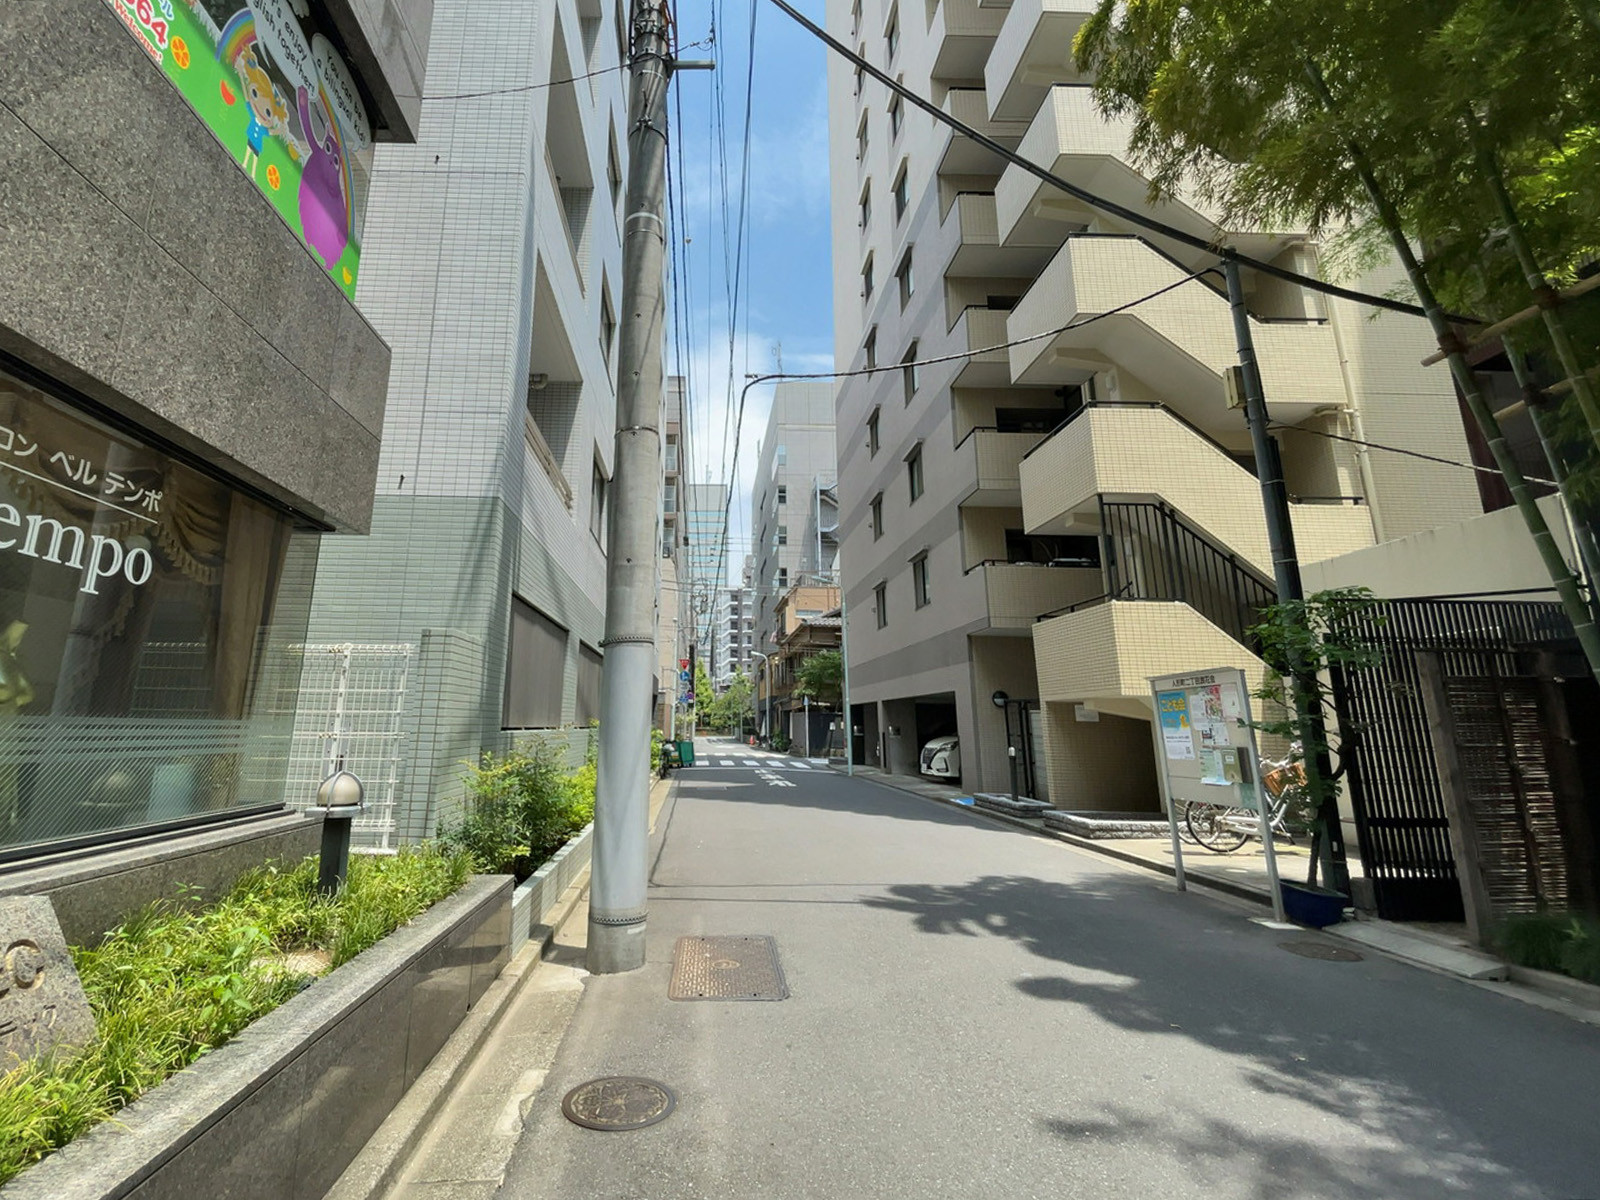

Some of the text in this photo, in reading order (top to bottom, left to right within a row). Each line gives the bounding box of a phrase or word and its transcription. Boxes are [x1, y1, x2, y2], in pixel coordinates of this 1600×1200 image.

[285, 21, 307, 61] enjoy
[326, 50, 363, 120] You can be
[50, 451, 97, 485] ベル
[105, 471, 163, 512] テンポ
